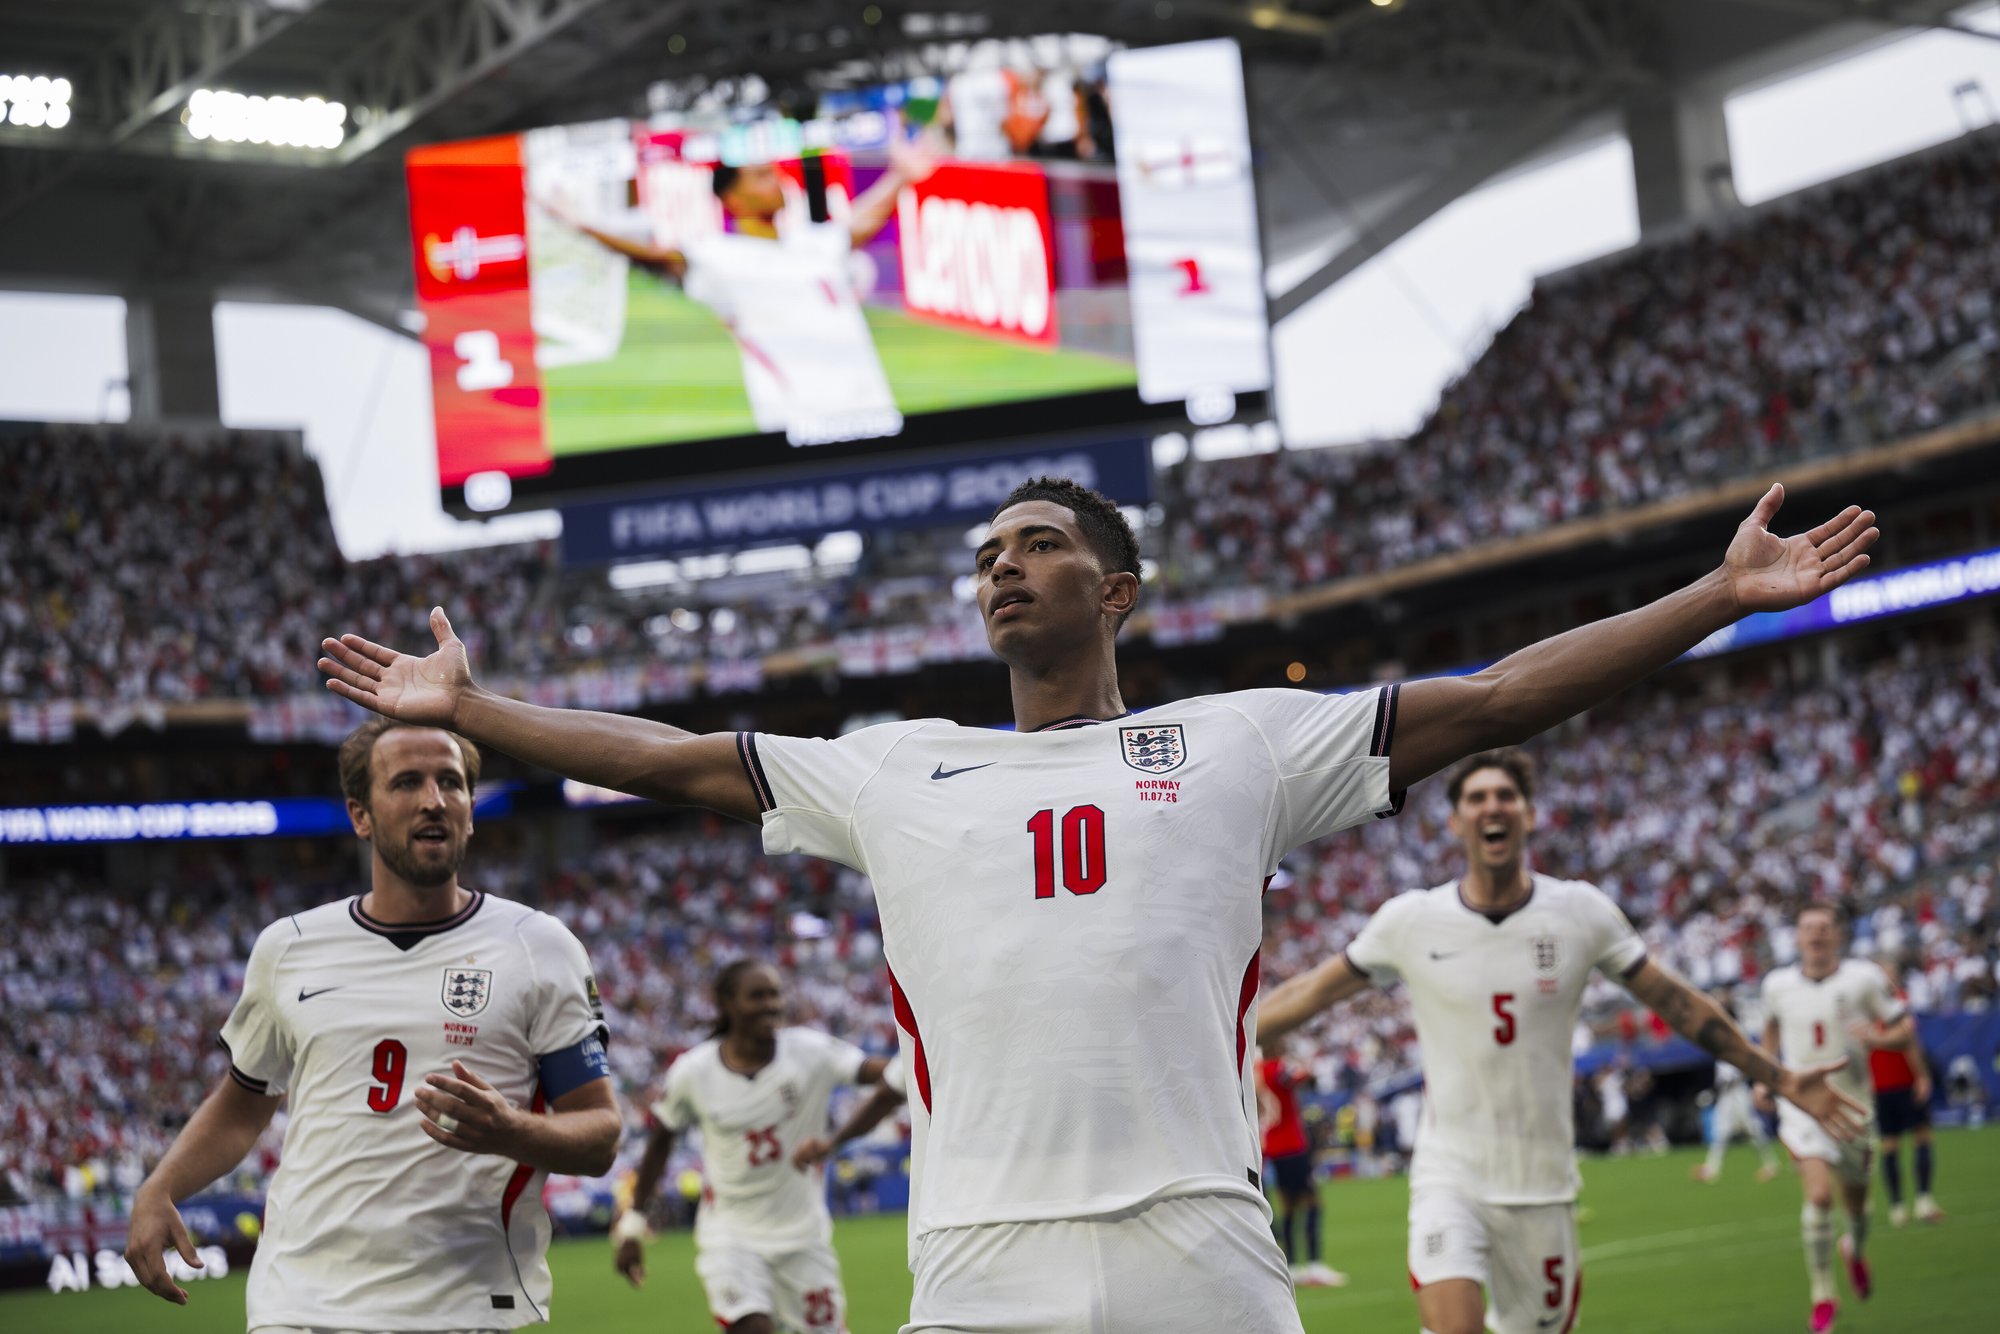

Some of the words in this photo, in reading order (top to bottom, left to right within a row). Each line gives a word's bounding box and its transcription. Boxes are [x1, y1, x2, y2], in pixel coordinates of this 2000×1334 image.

[1168, 258, 1211, 297] 1
[609, 500, 703, 548] FIFA
[703, 482, 855, 537] WORLD
[857, 472, 942, 521] CUP
[1135, 780, 1181, 791] NORWAY
[1139, 791, 1178, 803] 11.07.26
[46, 805, 137, 841] WORLD
[138, 803, 187, 838] CUP
[187, 800, 278, 837] 2026
[1027, 804, 1107, 899] 10
[443, 1021, 479, 1035] NORWAY
[1491, 991, 1516, 1047] 5
[367, 1038, 407, 1113] 9
[745, 1125, 783, 1168] 25
[48, 1251, 91, 1295] AI
[1543, 1255, 1565, 1311] 5
[803, 1287, 837, 1328] 25
